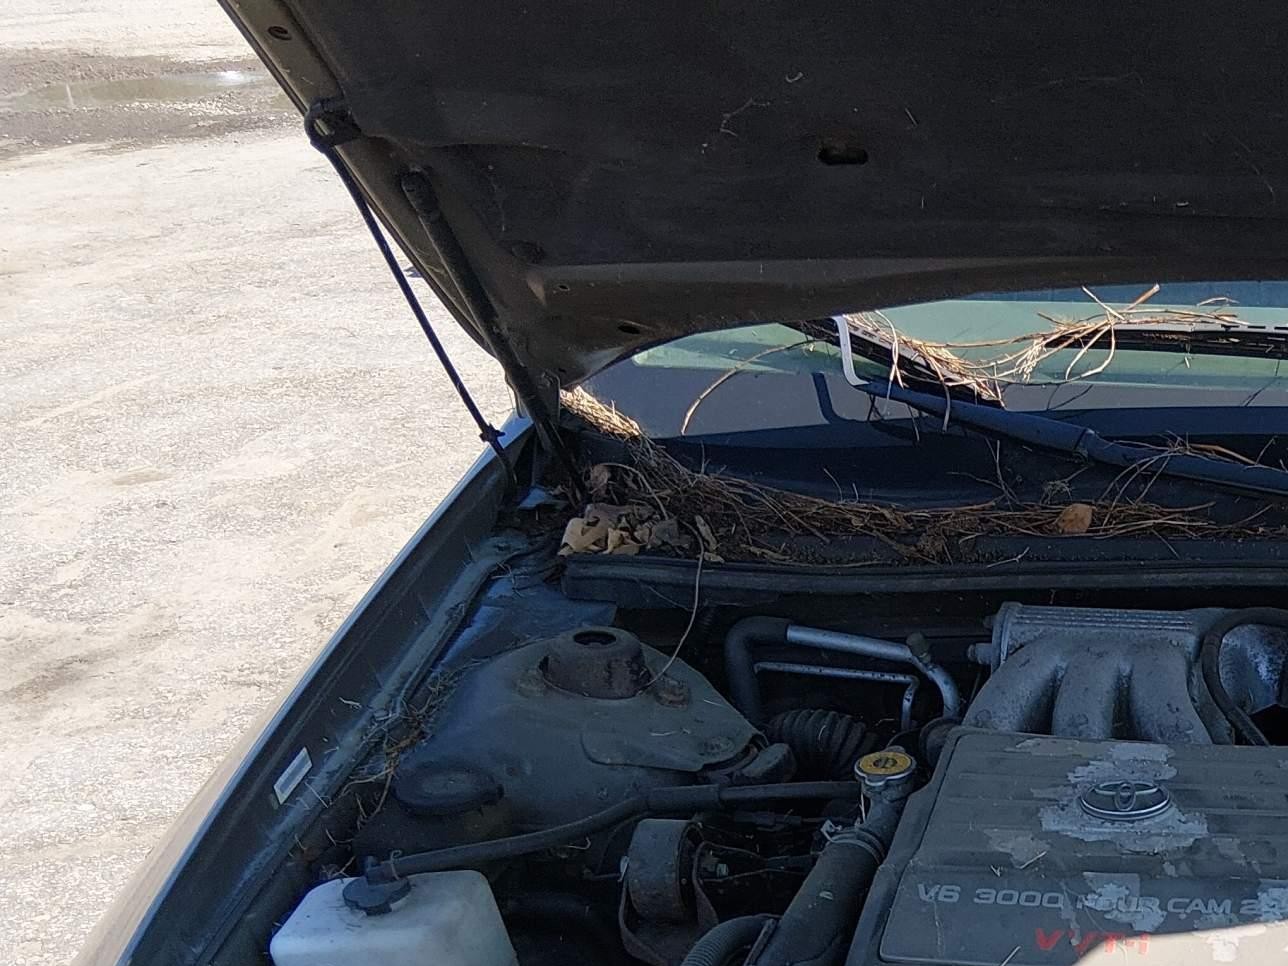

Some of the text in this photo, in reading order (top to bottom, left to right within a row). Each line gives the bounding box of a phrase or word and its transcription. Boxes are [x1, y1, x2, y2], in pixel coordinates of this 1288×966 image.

[917, 883, 961, 903] V6
[973, 888, 1066, 910] 3000
[1167, 897, 1233, 914] CAM
